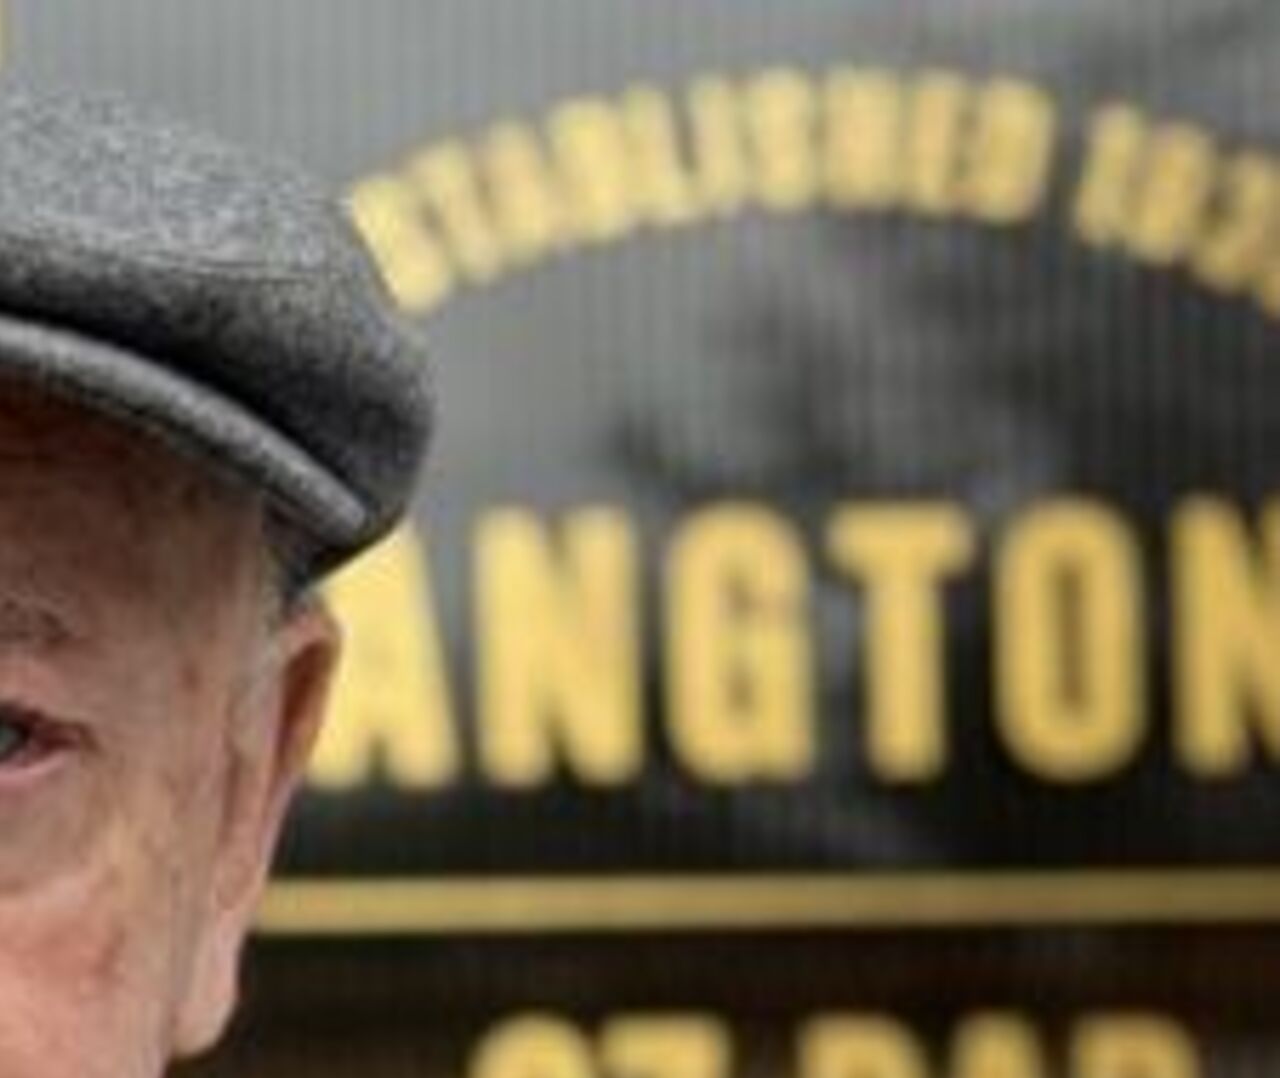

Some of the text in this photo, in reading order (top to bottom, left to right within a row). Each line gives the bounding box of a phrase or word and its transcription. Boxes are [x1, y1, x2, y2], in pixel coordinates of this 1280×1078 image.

[353, 72, 1280, 316] STABLISHED 193
[305, 500, 1280, 788] ANGTON
